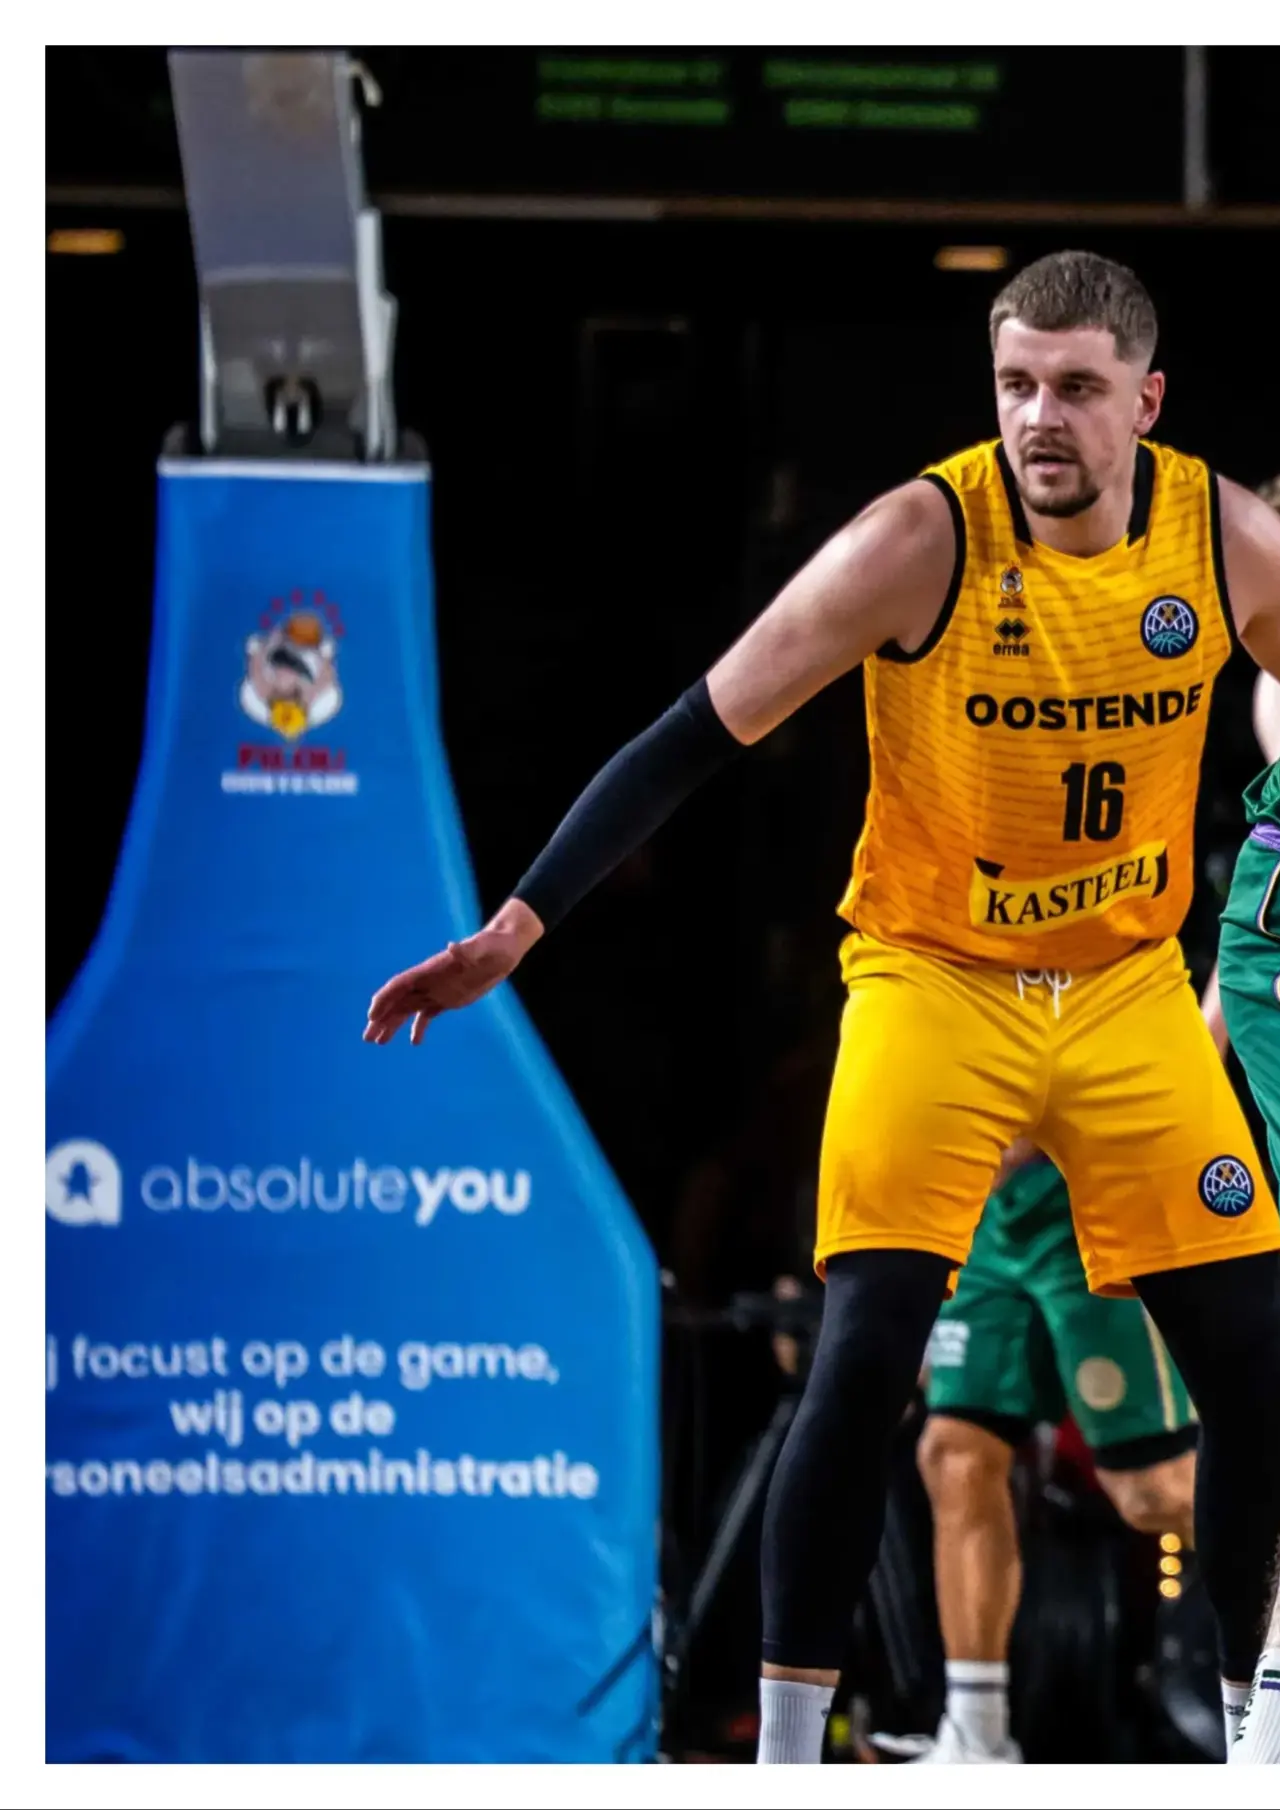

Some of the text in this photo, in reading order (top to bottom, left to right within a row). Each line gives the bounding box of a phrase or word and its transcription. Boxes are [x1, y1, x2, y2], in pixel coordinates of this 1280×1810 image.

[965, 682, 1204, 731] OOSTENDE
[1061, 761, 1126, 842] 16
[984, 856, 1151, 925] KASTEEL
[141, 1155, 531, 1228] absoluteyou
[72, 1333, 227, 1379] focust
[241, 1341, 309, 1389] op
[320, 1334, 387, 1378] de
[398, 1342, 559, 1390] game,
[169, 1388, 395, 1448] wij op de
